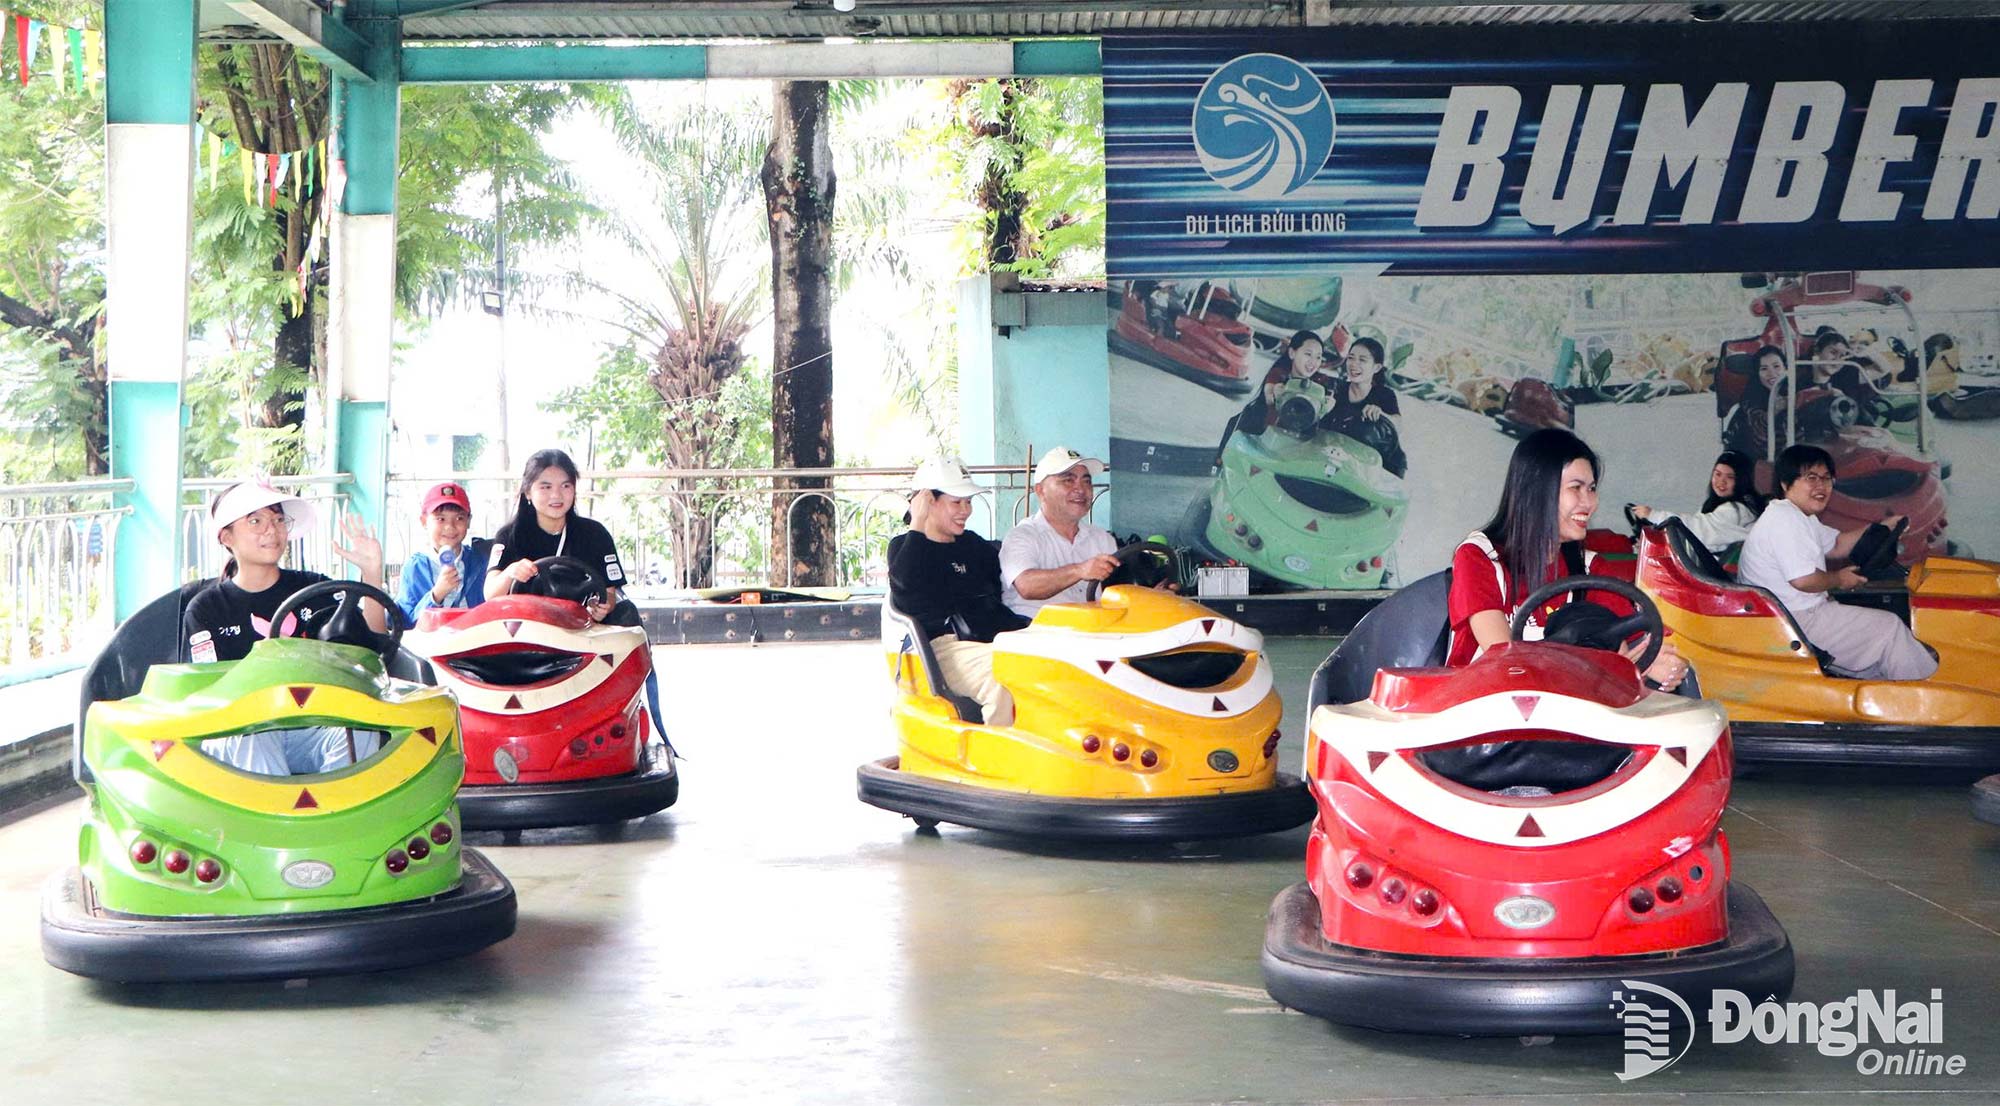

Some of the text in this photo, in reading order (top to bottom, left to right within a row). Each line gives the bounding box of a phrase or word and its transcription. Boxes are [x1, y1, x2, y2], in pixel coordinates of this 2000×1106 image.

[1186, 214, 1208, 235] DU
[1261, 207, 1295, 233] BỬU
[1302, 213, 1346, 232] LONG
